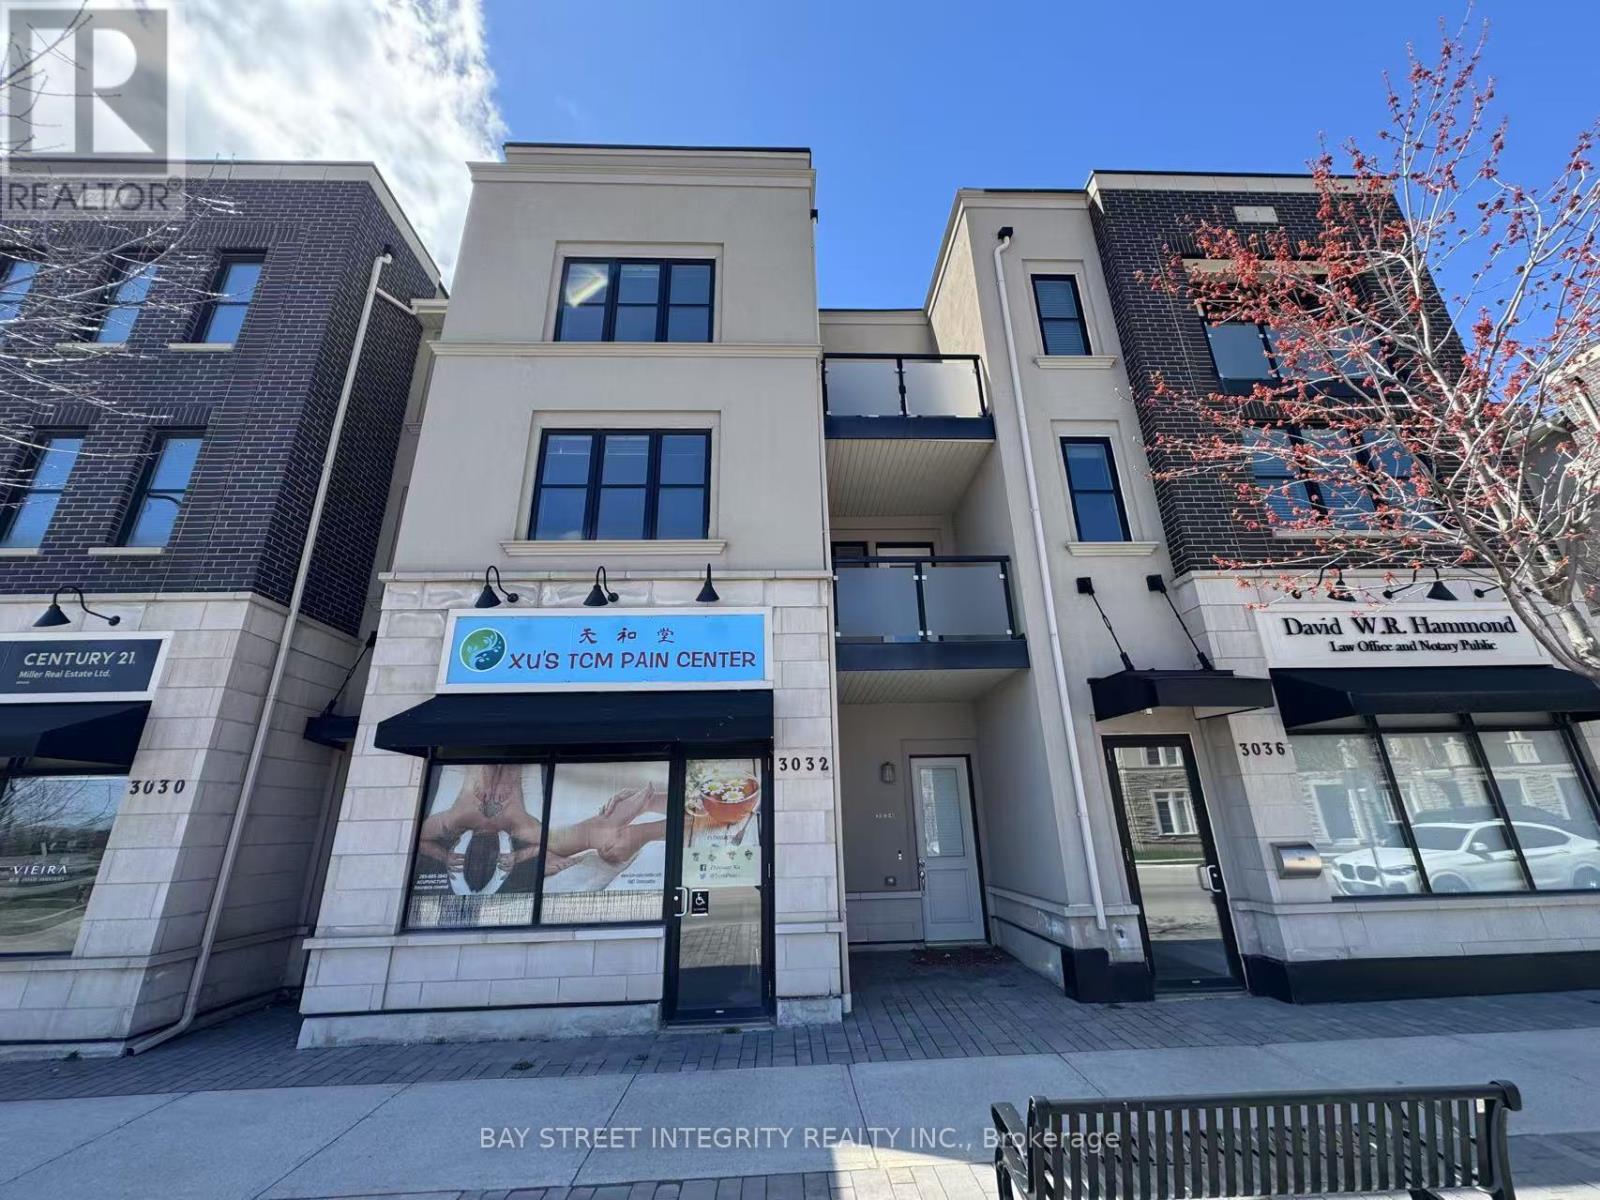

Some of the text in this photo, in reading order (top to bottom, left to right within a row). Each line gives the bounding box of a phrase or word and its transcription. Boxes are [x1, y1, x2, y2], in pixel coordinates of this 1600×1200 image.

[1282, 616, 1344, 635] David
[1409, 616, 1518, 634] Hammond
[1329, 639, 1498, 653] Law Office and Notary Public
[24, 651, 136, 666] CENTURY 21
[508, 650, 757, 670] XU'S TCM PAIN CENTER
[18, 669, 112, 679] Miller Real Estate Ltd.
[1239, 741, 1286, 757] 3036
[778, 756, 829, 771] 3032
[129, 779, 186, 795] 3030
